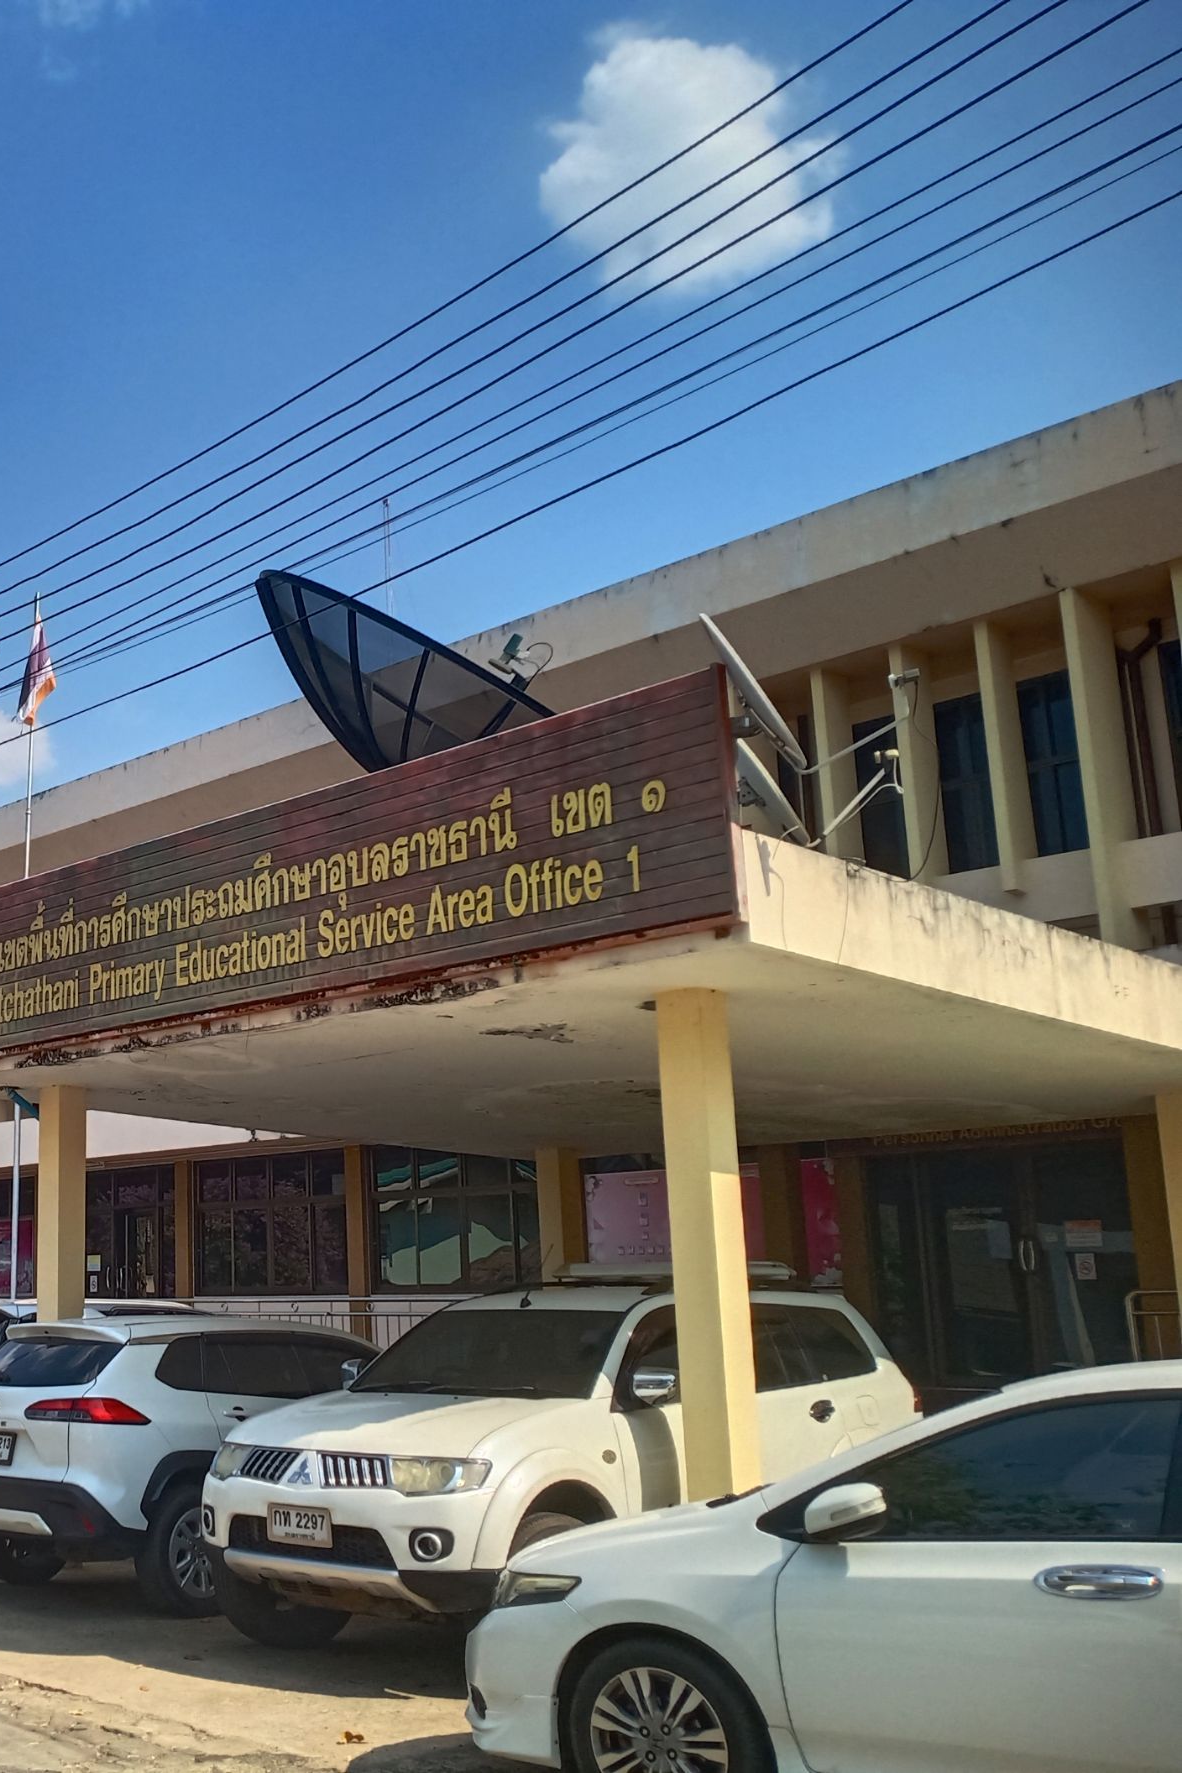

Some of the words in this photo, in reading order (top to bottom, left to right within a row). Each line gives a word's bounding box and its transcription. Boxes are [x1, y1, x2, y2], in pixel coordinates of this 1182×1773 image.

[551, 783, 612, 838] เขต
[641, 779, 666, 812] ๑
[89, 959, 165, 1005] Primary
[175, 918, 307, 987] Educational
[317, 902, 416, 958] Service
[426, 886, 493, 935] Area
[504, 856, 604, 918] Office
[626, 845, 640, 891] 1
[274, 1510, 291, 1527] กท
[295, 1512, 325, 1531] 2297
